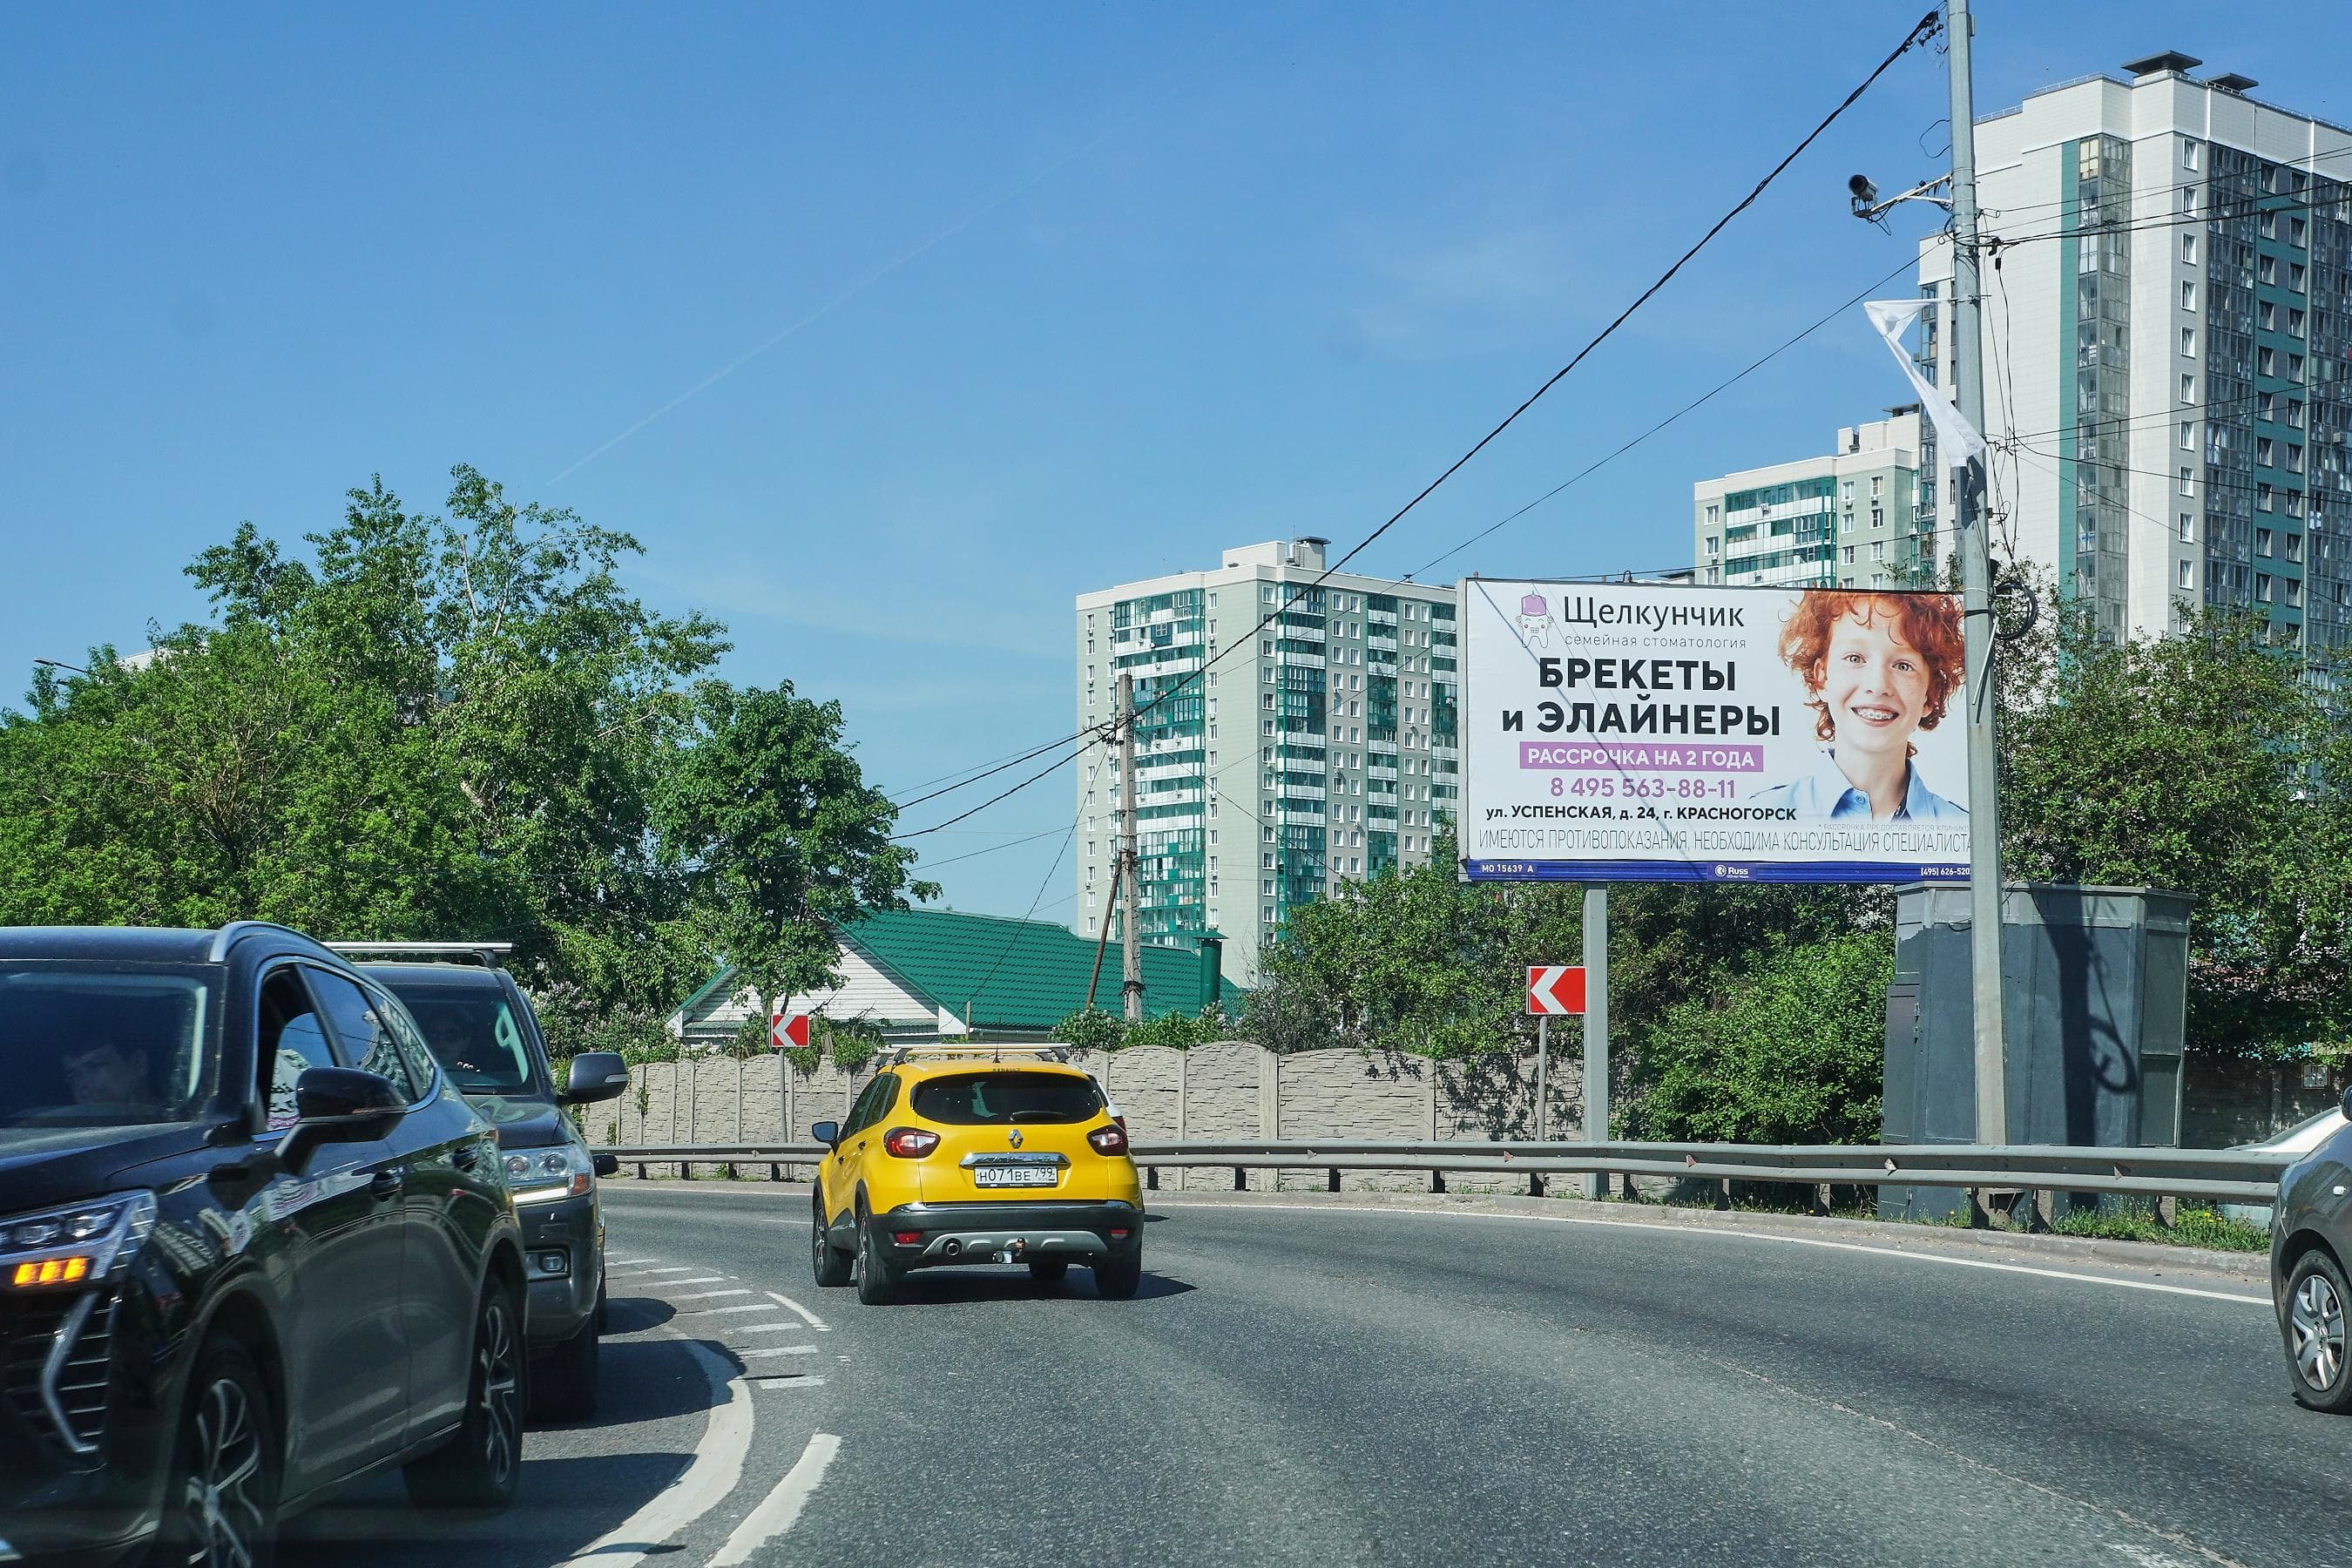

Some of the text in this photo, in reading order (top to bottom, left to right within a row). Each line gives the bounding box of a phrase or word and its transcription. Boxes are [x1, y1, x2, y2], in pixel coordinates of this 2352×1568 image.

[1564, 596, 1745, 632] Щелкунчик
[1565, 634, 1747, 650] семейная стоматология
[1539, 657, 1735, 691] БРЕКЕТЫ
[1502, 693, 1781, 736] и ЭЛАЙНЕРЫ
[1528, 748, 1755, 769] РАССРОЧКА НА 2 ГОДА
[1551, 777, 1735, 799] 8 495 563-88-11
[1486, 805, 1796, 821] ул. УСПЕНСКАЯ, д. 24, г. КРАСНОГОРСК
[1479, 828, 1544, 848] ИМЕЮТСЯ
[1549, 829, 1690, 851] ПРОТИВОПОКАЗАНИЯ,
[1694, 830, 1780, 853] НЕОБХОДИМА
[1784, 831, 1879, 853] КОНСУЛЬТАЦИЯ
[1482, 864, 1495, 873] МО
[1497, 864, 1523, 873] 15639
[1921, 867, 1970, 876] (495) 626-520
[1033, 1167, 1053, 1178] 799
